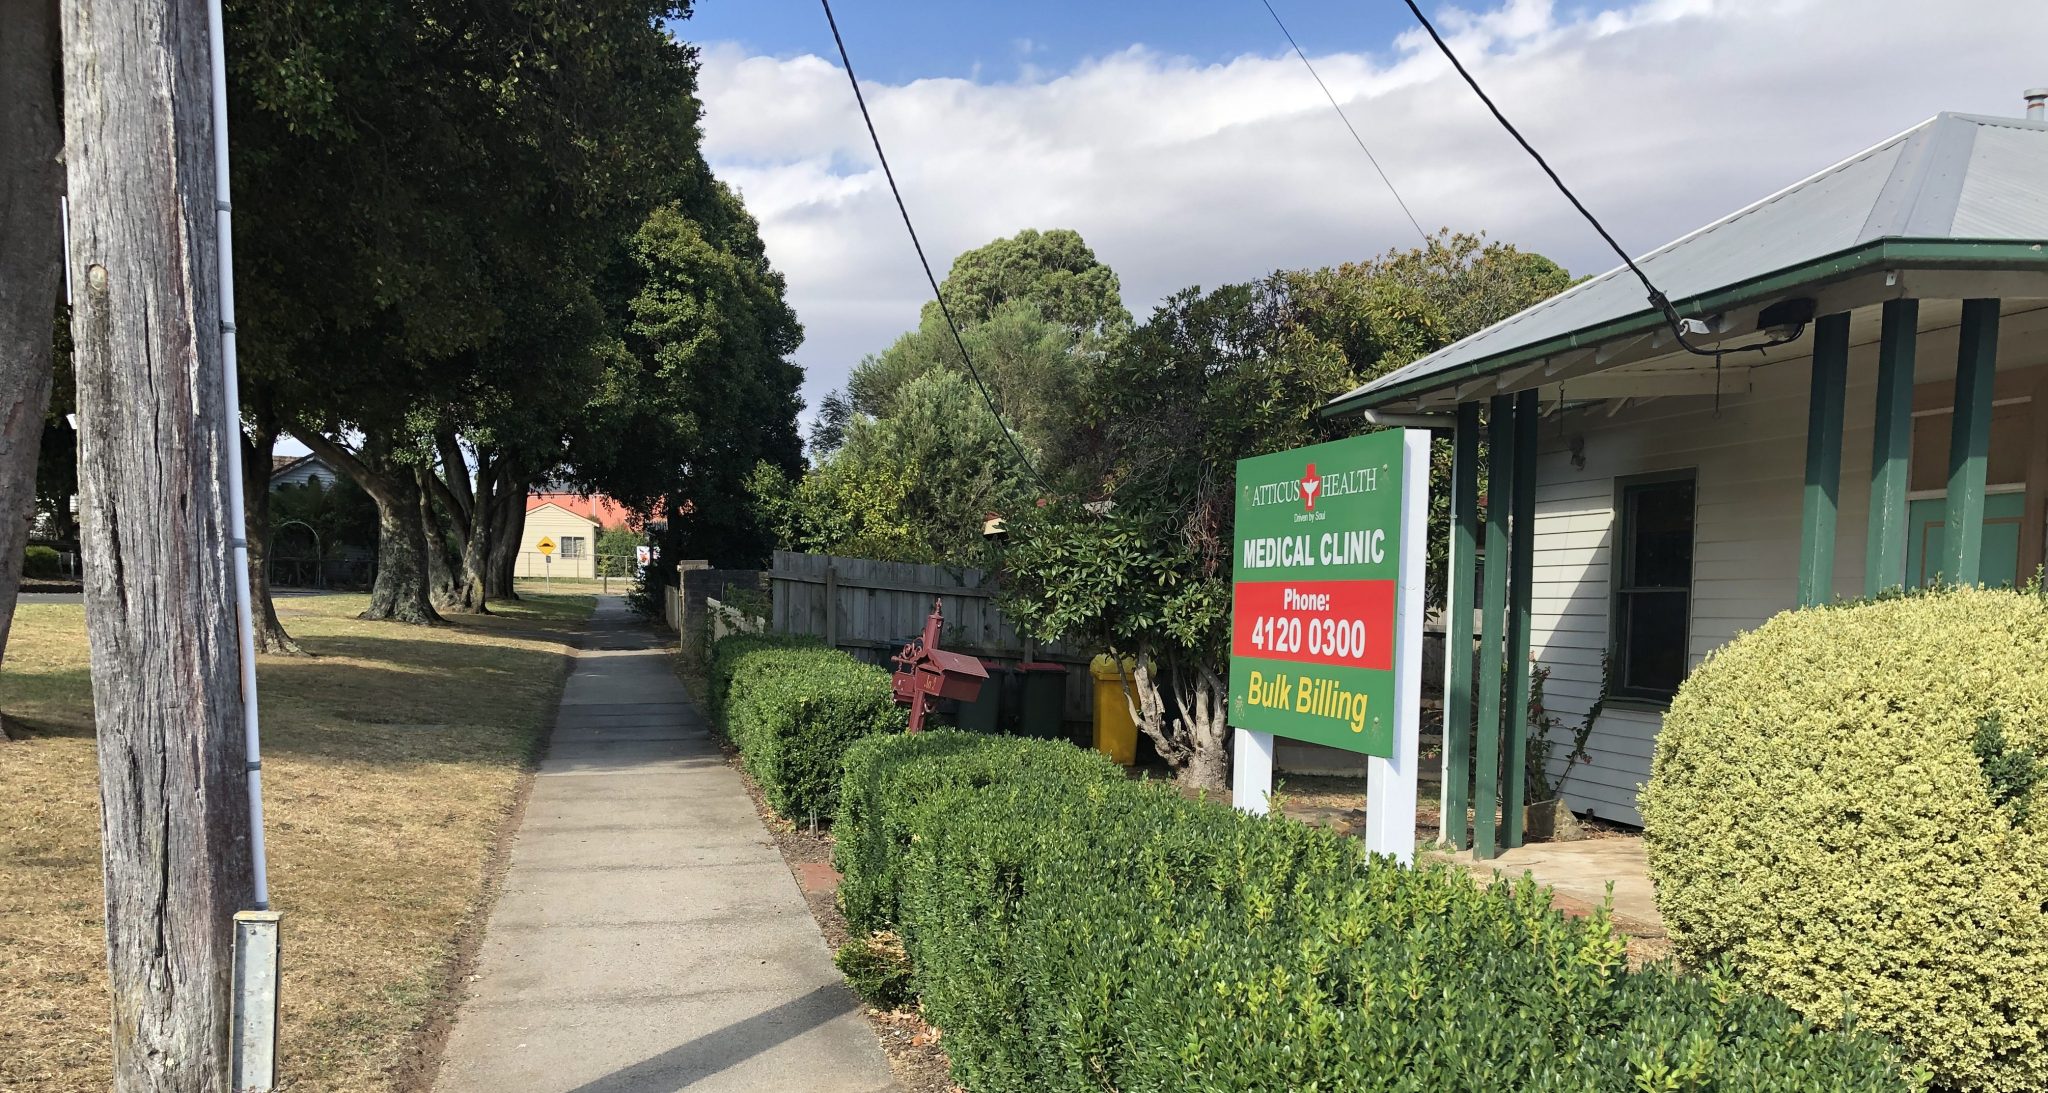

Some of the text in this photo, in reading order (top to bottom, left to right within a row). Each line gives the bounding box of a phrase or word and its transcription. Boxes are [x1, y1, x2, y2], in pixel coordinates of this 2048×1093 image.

[1252, 468, 1377, 507] ATTICUS HEALTH
[1293, 510, 1326, 524] Driven by Soul
[1243, 528, 1385, 569] MEDICAL CLINIC
[1284, 588, 1330, 611] Phone:
[1251, 616, 1366, 659] 4120 0300
[1247, 670, 1368, 733] Bulk Billing
